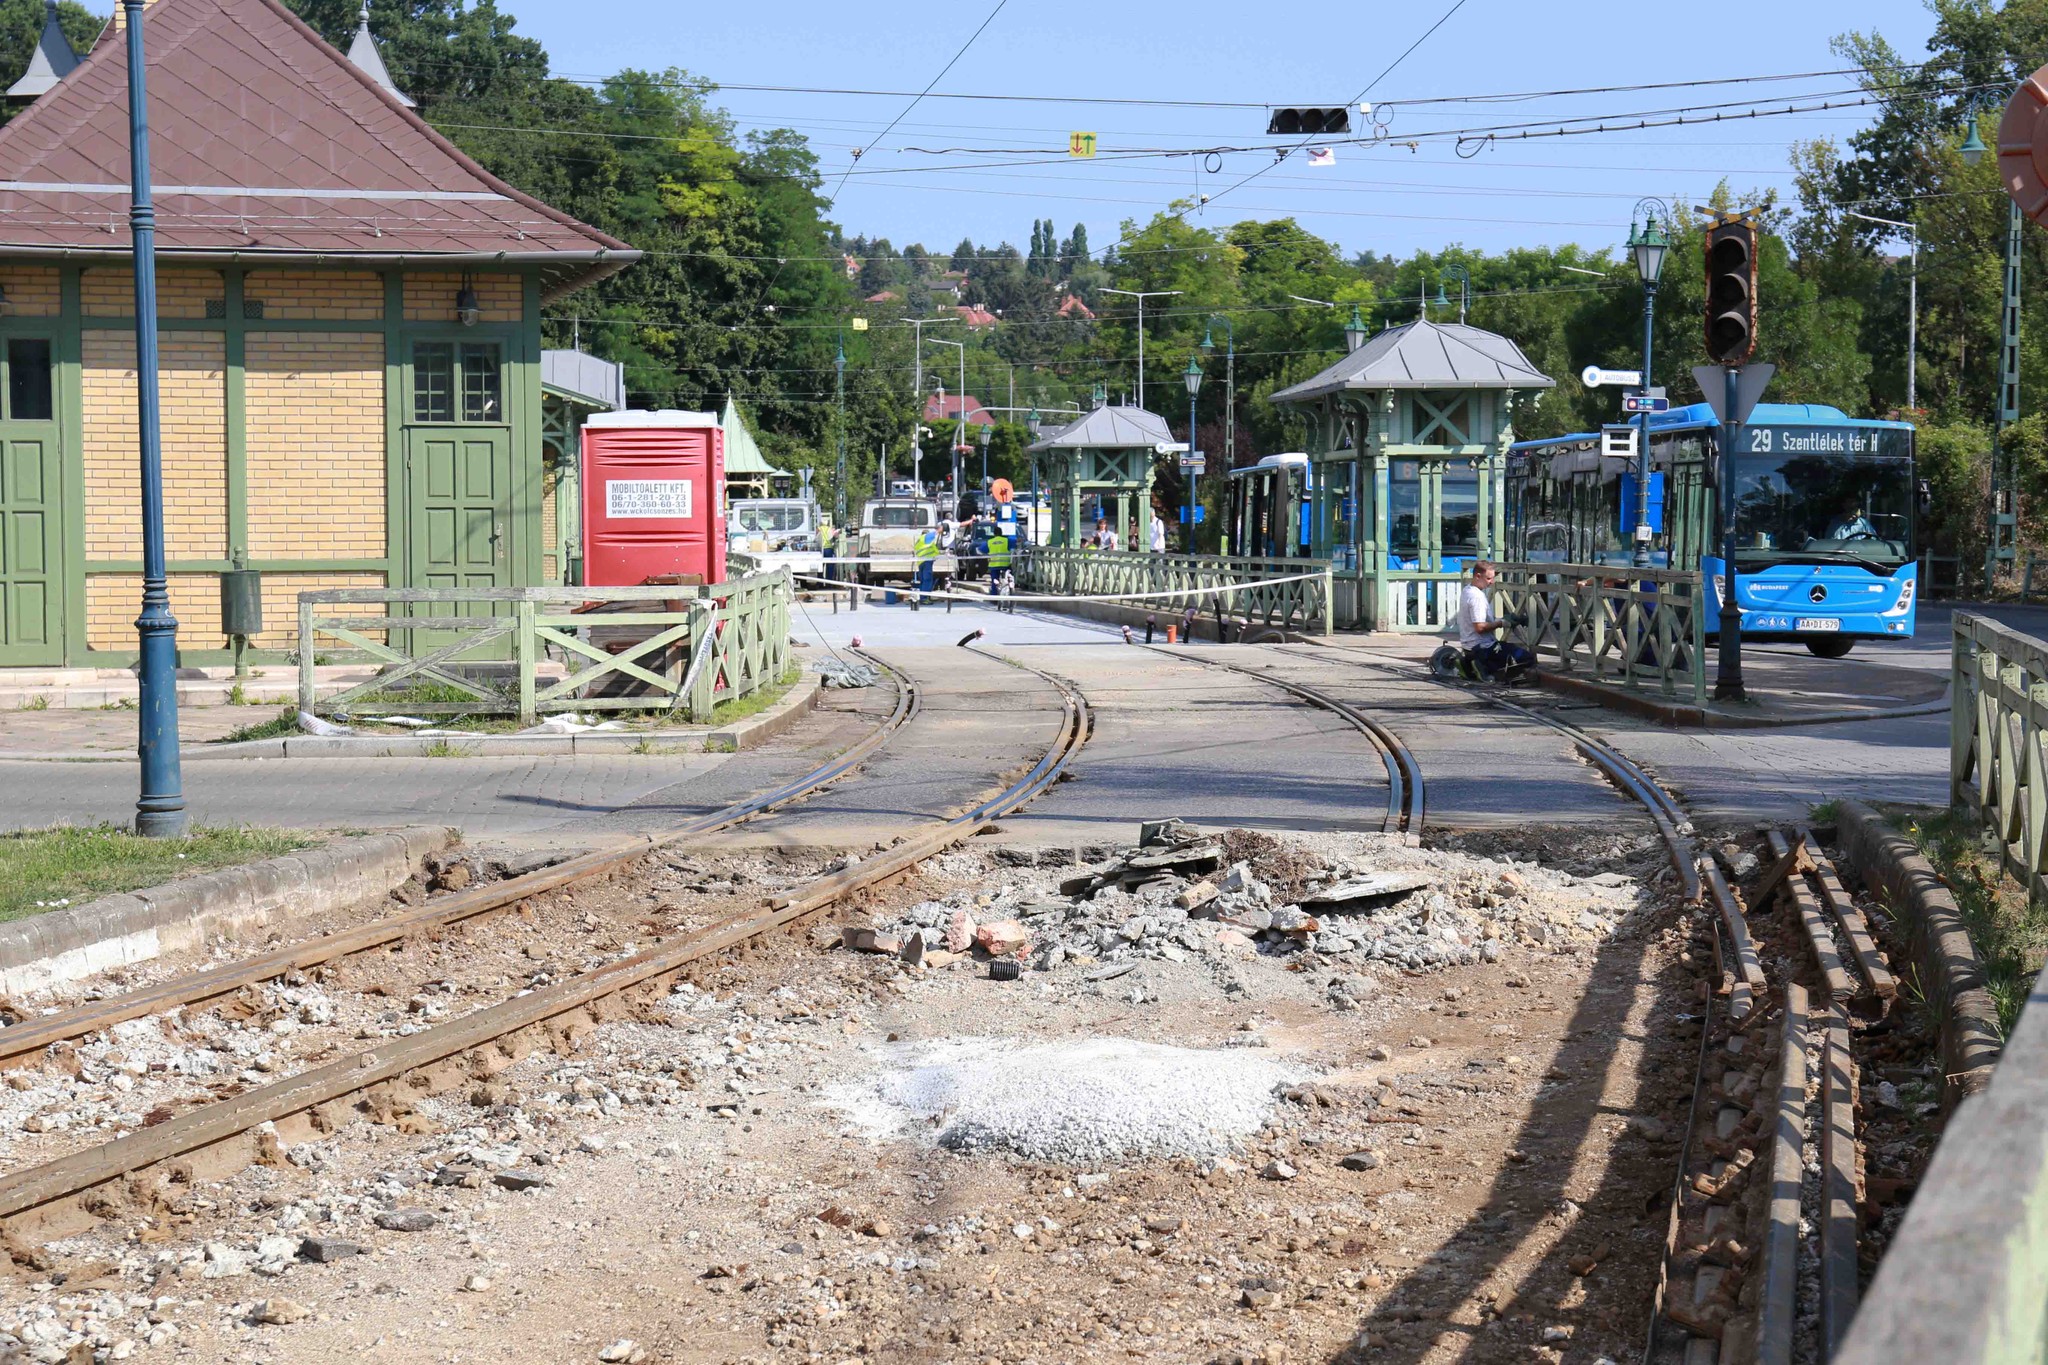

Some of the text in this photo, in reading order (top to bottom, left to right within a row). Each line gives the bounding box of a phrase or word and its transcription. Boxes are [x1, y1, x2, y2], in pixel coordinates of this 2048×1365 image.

[1604, 374, 1636, 382] AUTOBUSZ
[1751, 429, 1772, 452] 29
[1782, 432, 1844, 451] Szentlélek
[1848, 433, 1866, 451] tér
[611, 483, 687, 494] MOBILTOALETT KFT.
